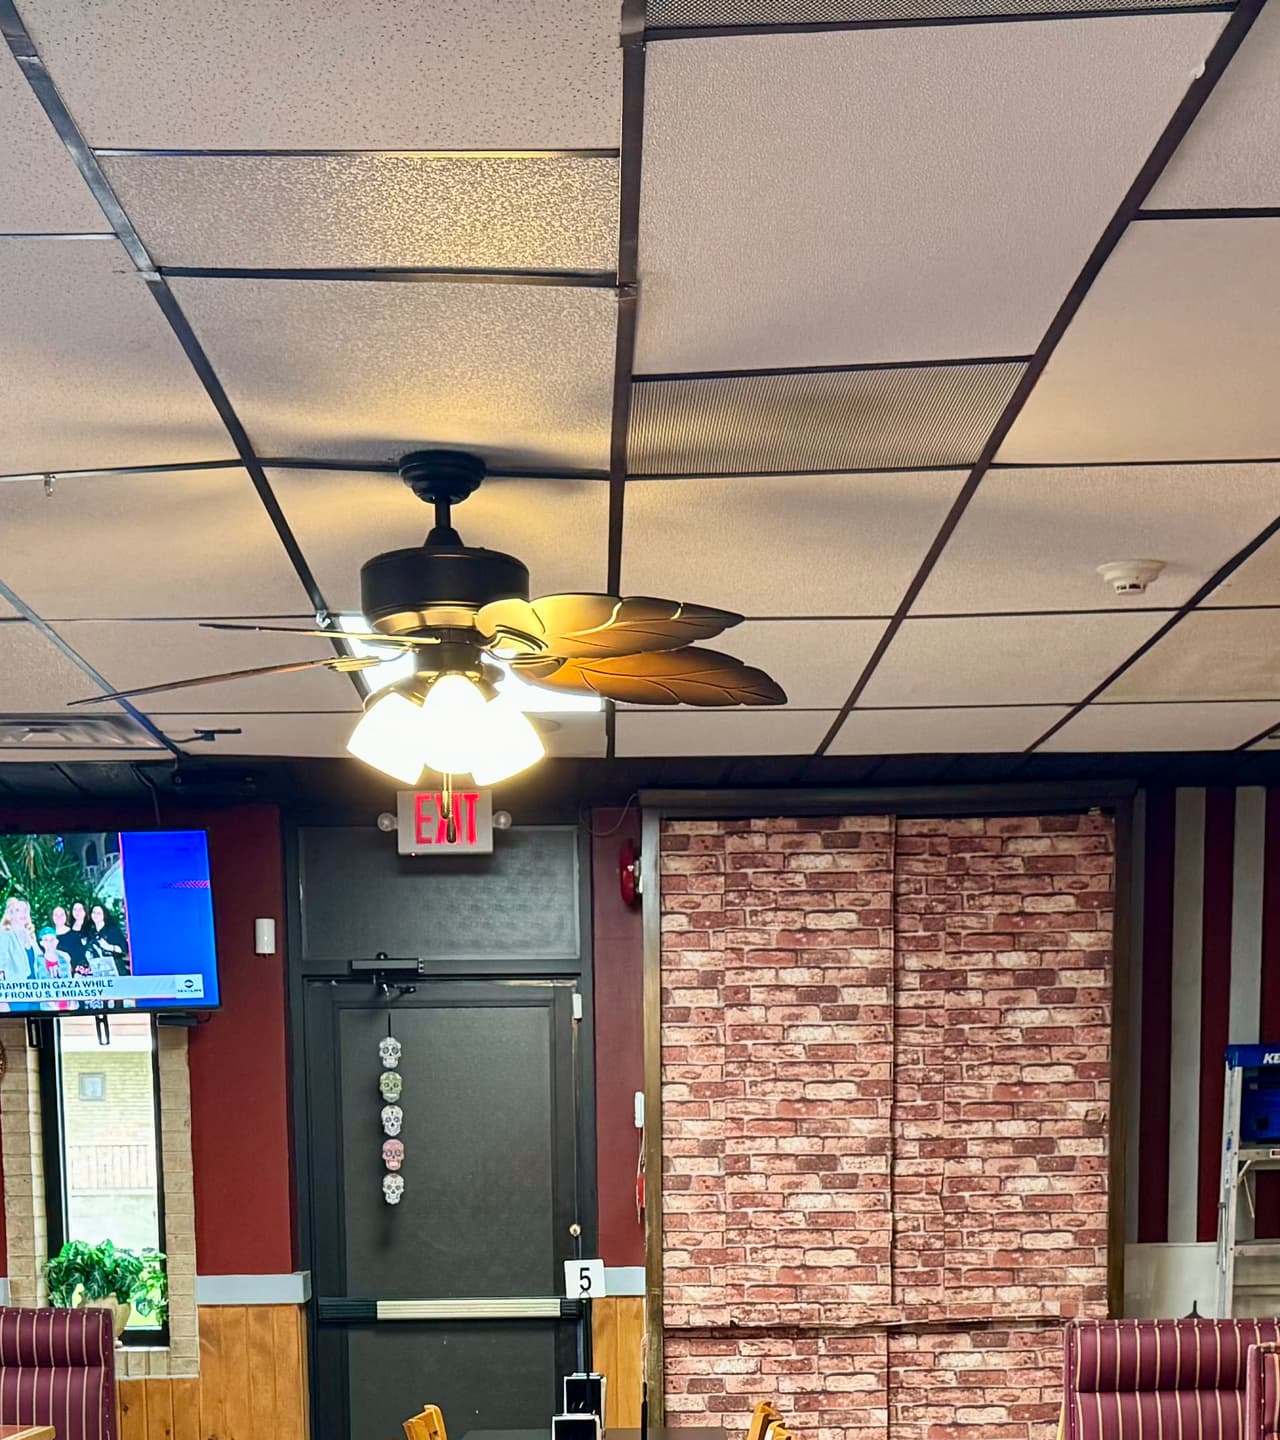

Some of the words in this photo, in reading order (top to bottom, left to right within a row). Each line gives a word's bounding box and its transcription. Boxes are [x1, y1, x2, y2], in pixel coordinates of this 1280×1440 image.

[415, 792, 480, 845] EXIT
[41, 982, 51, 990] IN
[52, 981, 80, 990] GAZA
[82, 979, 114, 989] WHILE
[5, 991, 34, 999] FROM
[55, 989, 103, 998] EMBASSY
[579, 1267, 592, 1291] 5
